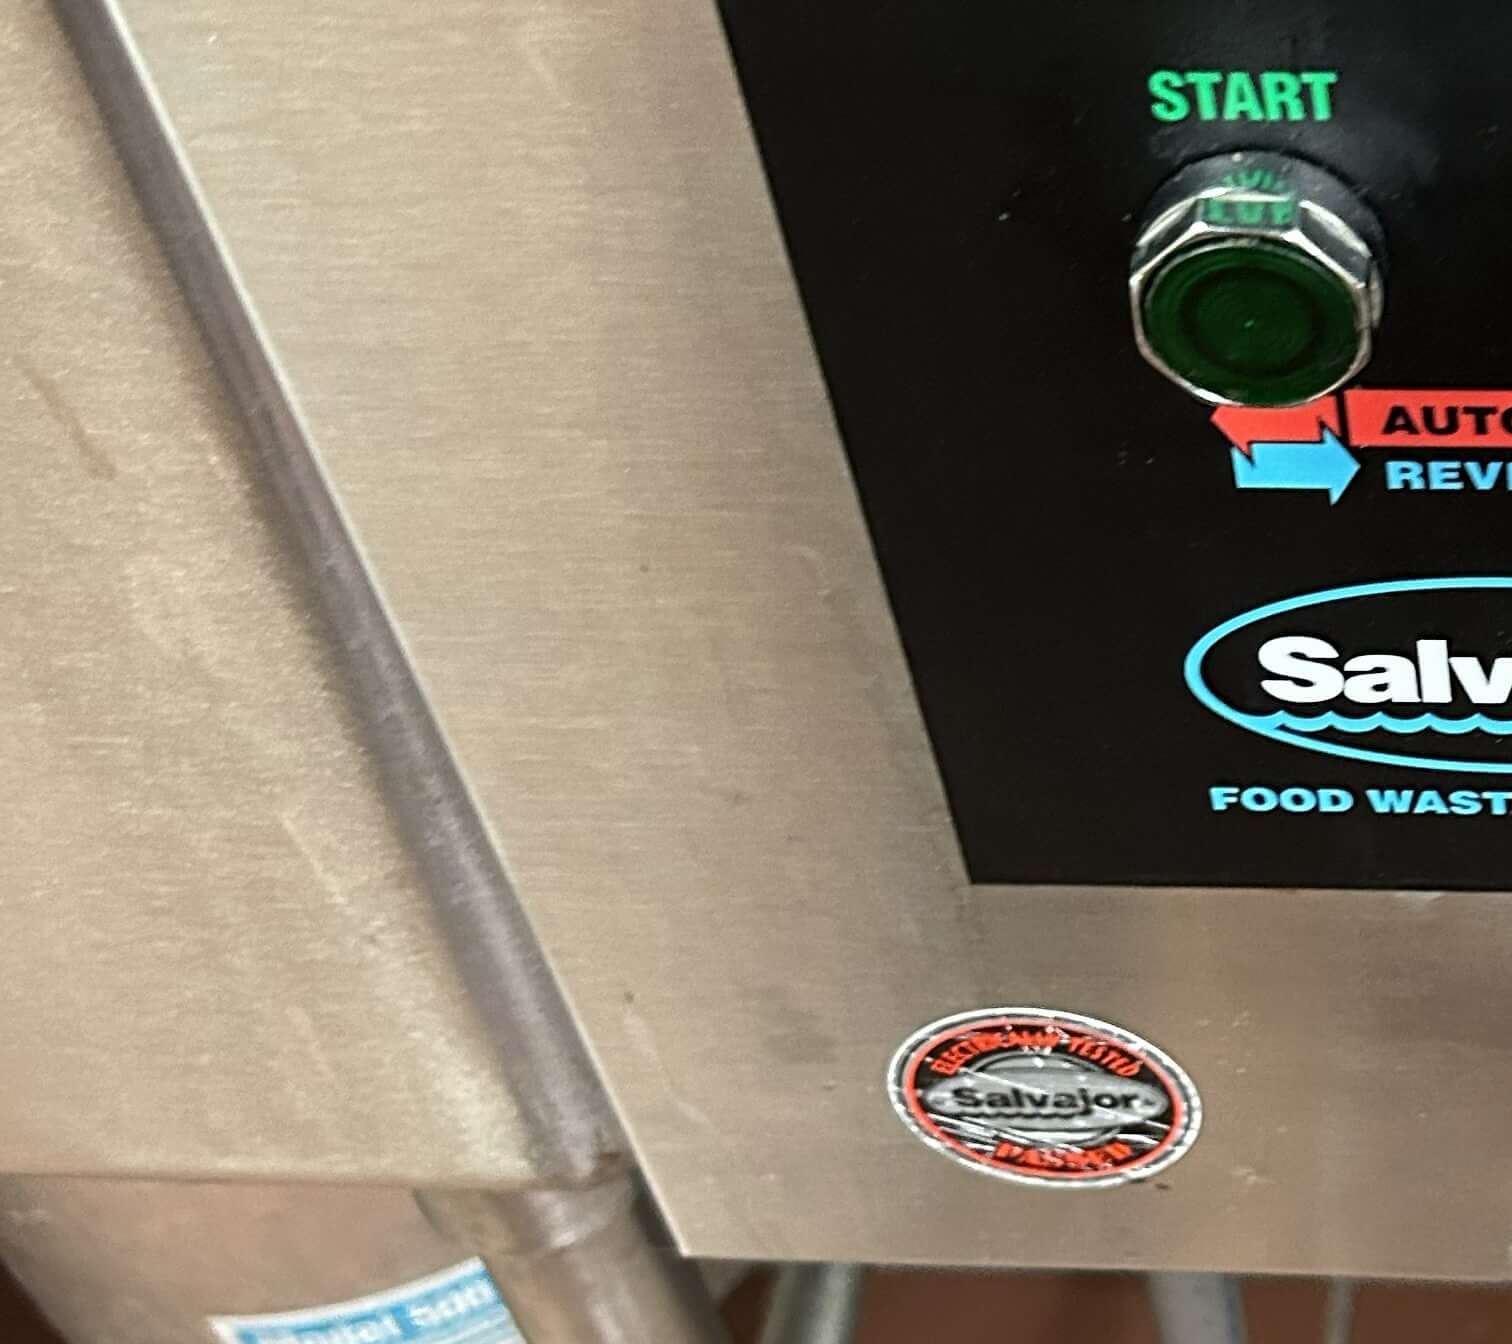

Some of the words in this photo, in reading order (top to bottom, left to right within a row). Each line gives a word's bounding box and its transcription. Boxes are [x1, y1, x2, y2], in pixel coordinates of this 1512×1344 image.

[1147, 70, 1338, 123] START
[1209, 786, 1354, 814] FOOD
[1067, 1036, 1140, 1077] TESTED
[952, 1086, 1139, 1117] Salvajor
